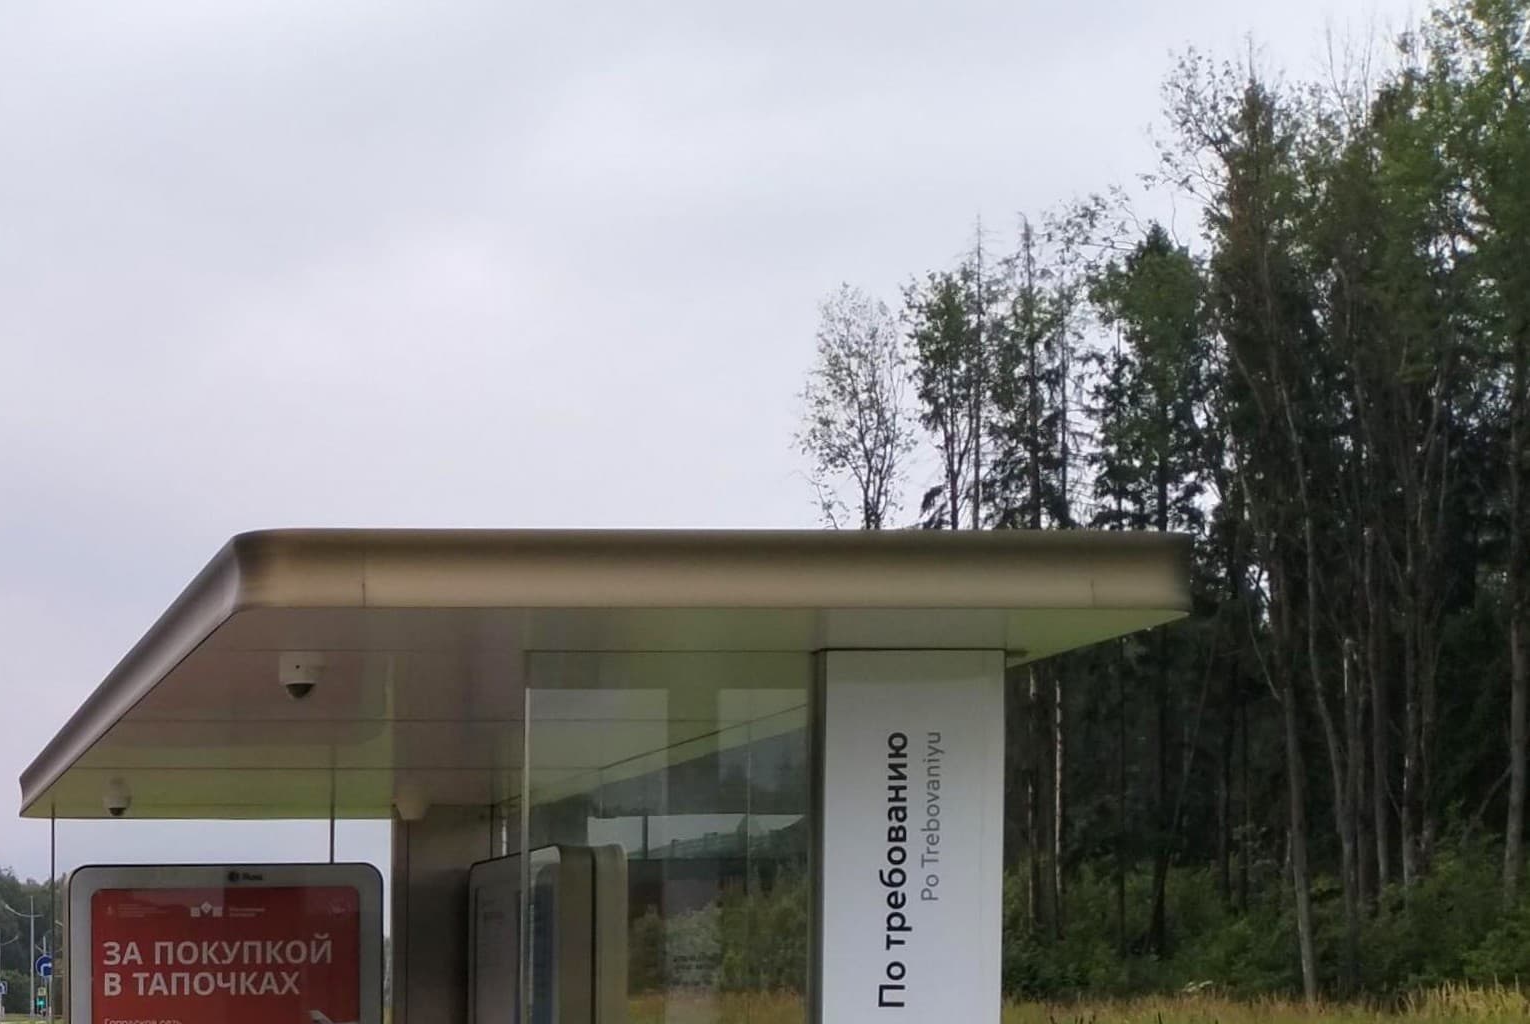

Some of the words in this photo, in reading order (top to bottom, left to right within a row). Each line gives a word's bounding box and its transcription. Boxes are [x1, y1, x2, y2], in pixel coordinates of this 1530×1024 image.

[920, 731, 944, 869] Trebovaniyu
[879, 731, 912, 950] требованию
[921, 873, 940, 902] Po
[103, 941, 143, 966] ЗА
[154, 932, 332, 966] ПОКУПКОЙ
[103, 973, 122, 996] В
[132, 971, 301, 996] ТАПОЧКАХ
[878, 957, 906, 1008] По
